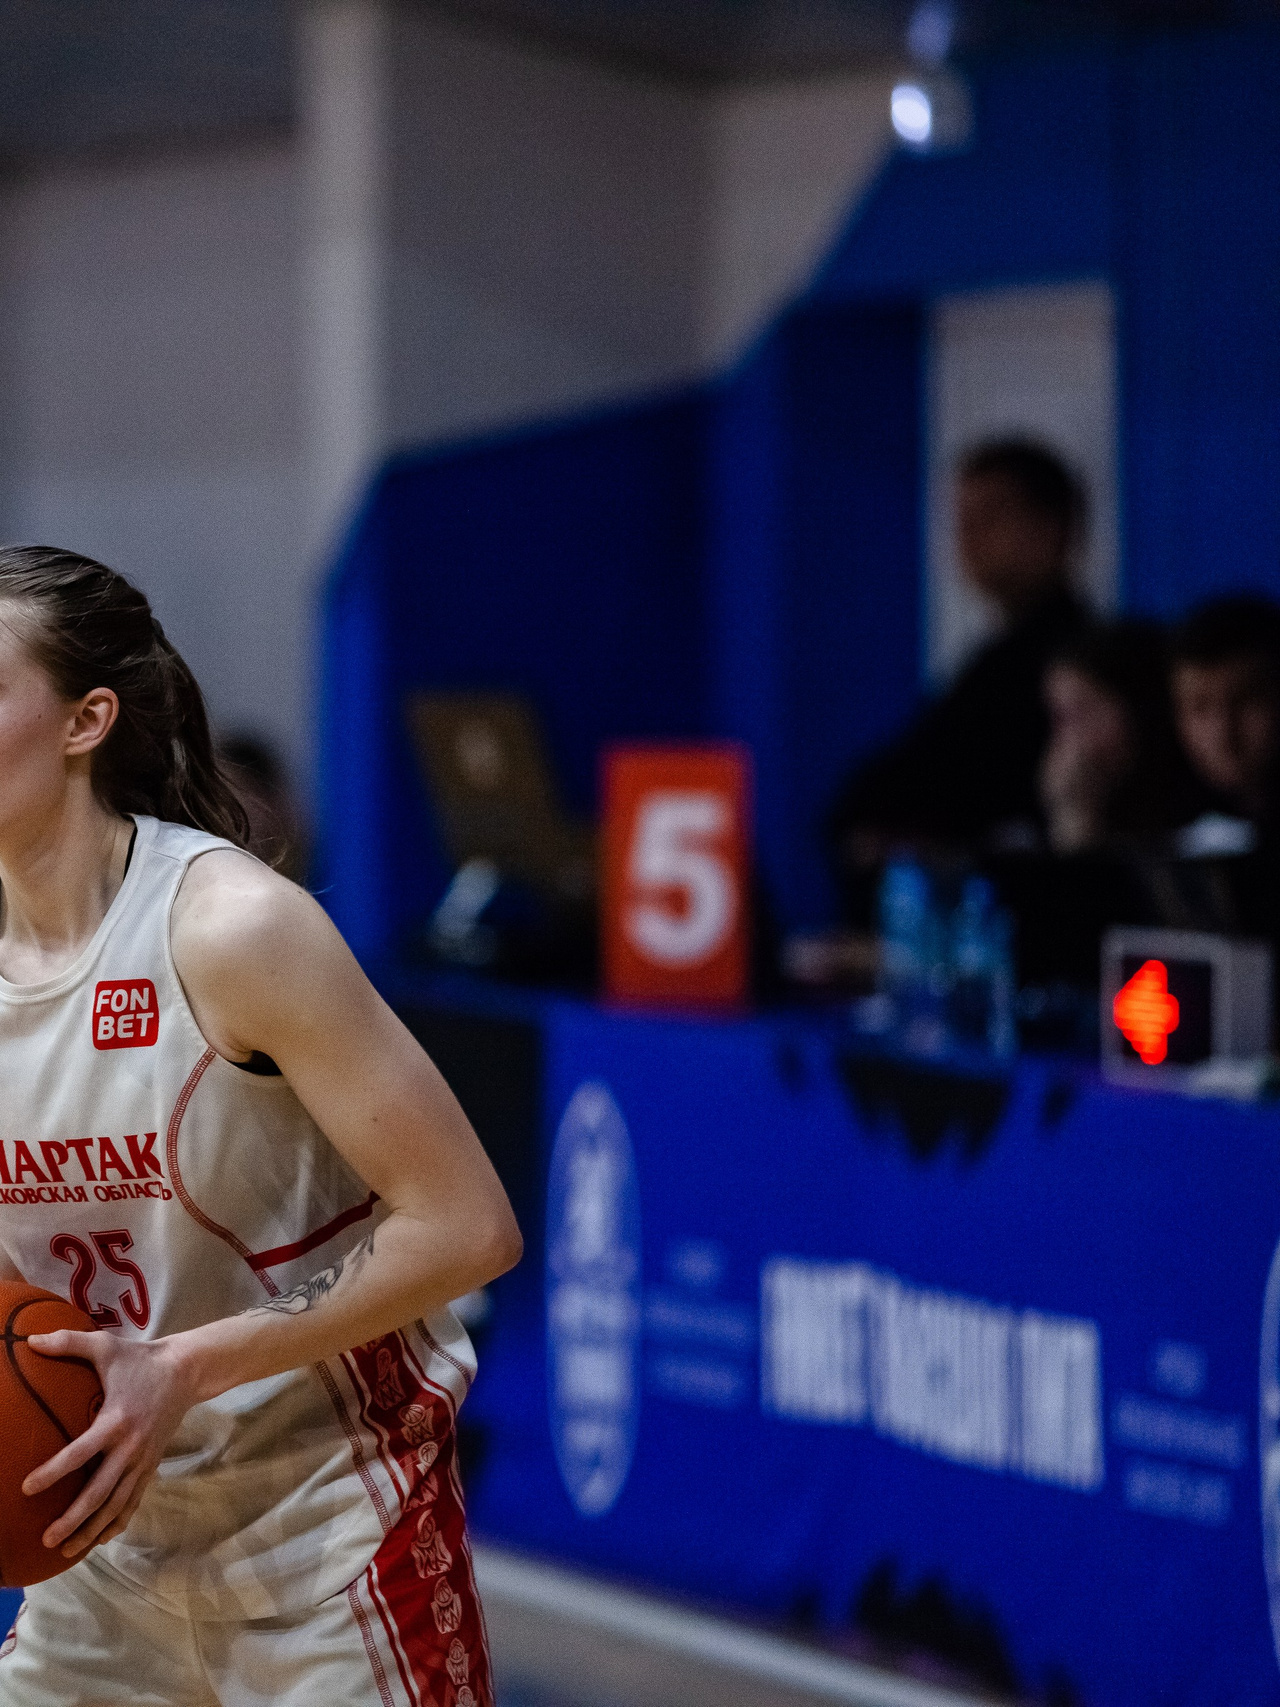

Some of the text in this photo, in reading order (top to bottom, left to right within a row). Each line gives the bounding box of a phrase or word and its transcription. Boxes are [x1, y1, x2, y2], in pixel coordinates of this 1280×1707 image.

[626, 793, 736, 966] 5
[95, 987, 150, 1014] FON
[96, 1012, 155, 1041] BET
[49, 1228, 151, 1331] 25
